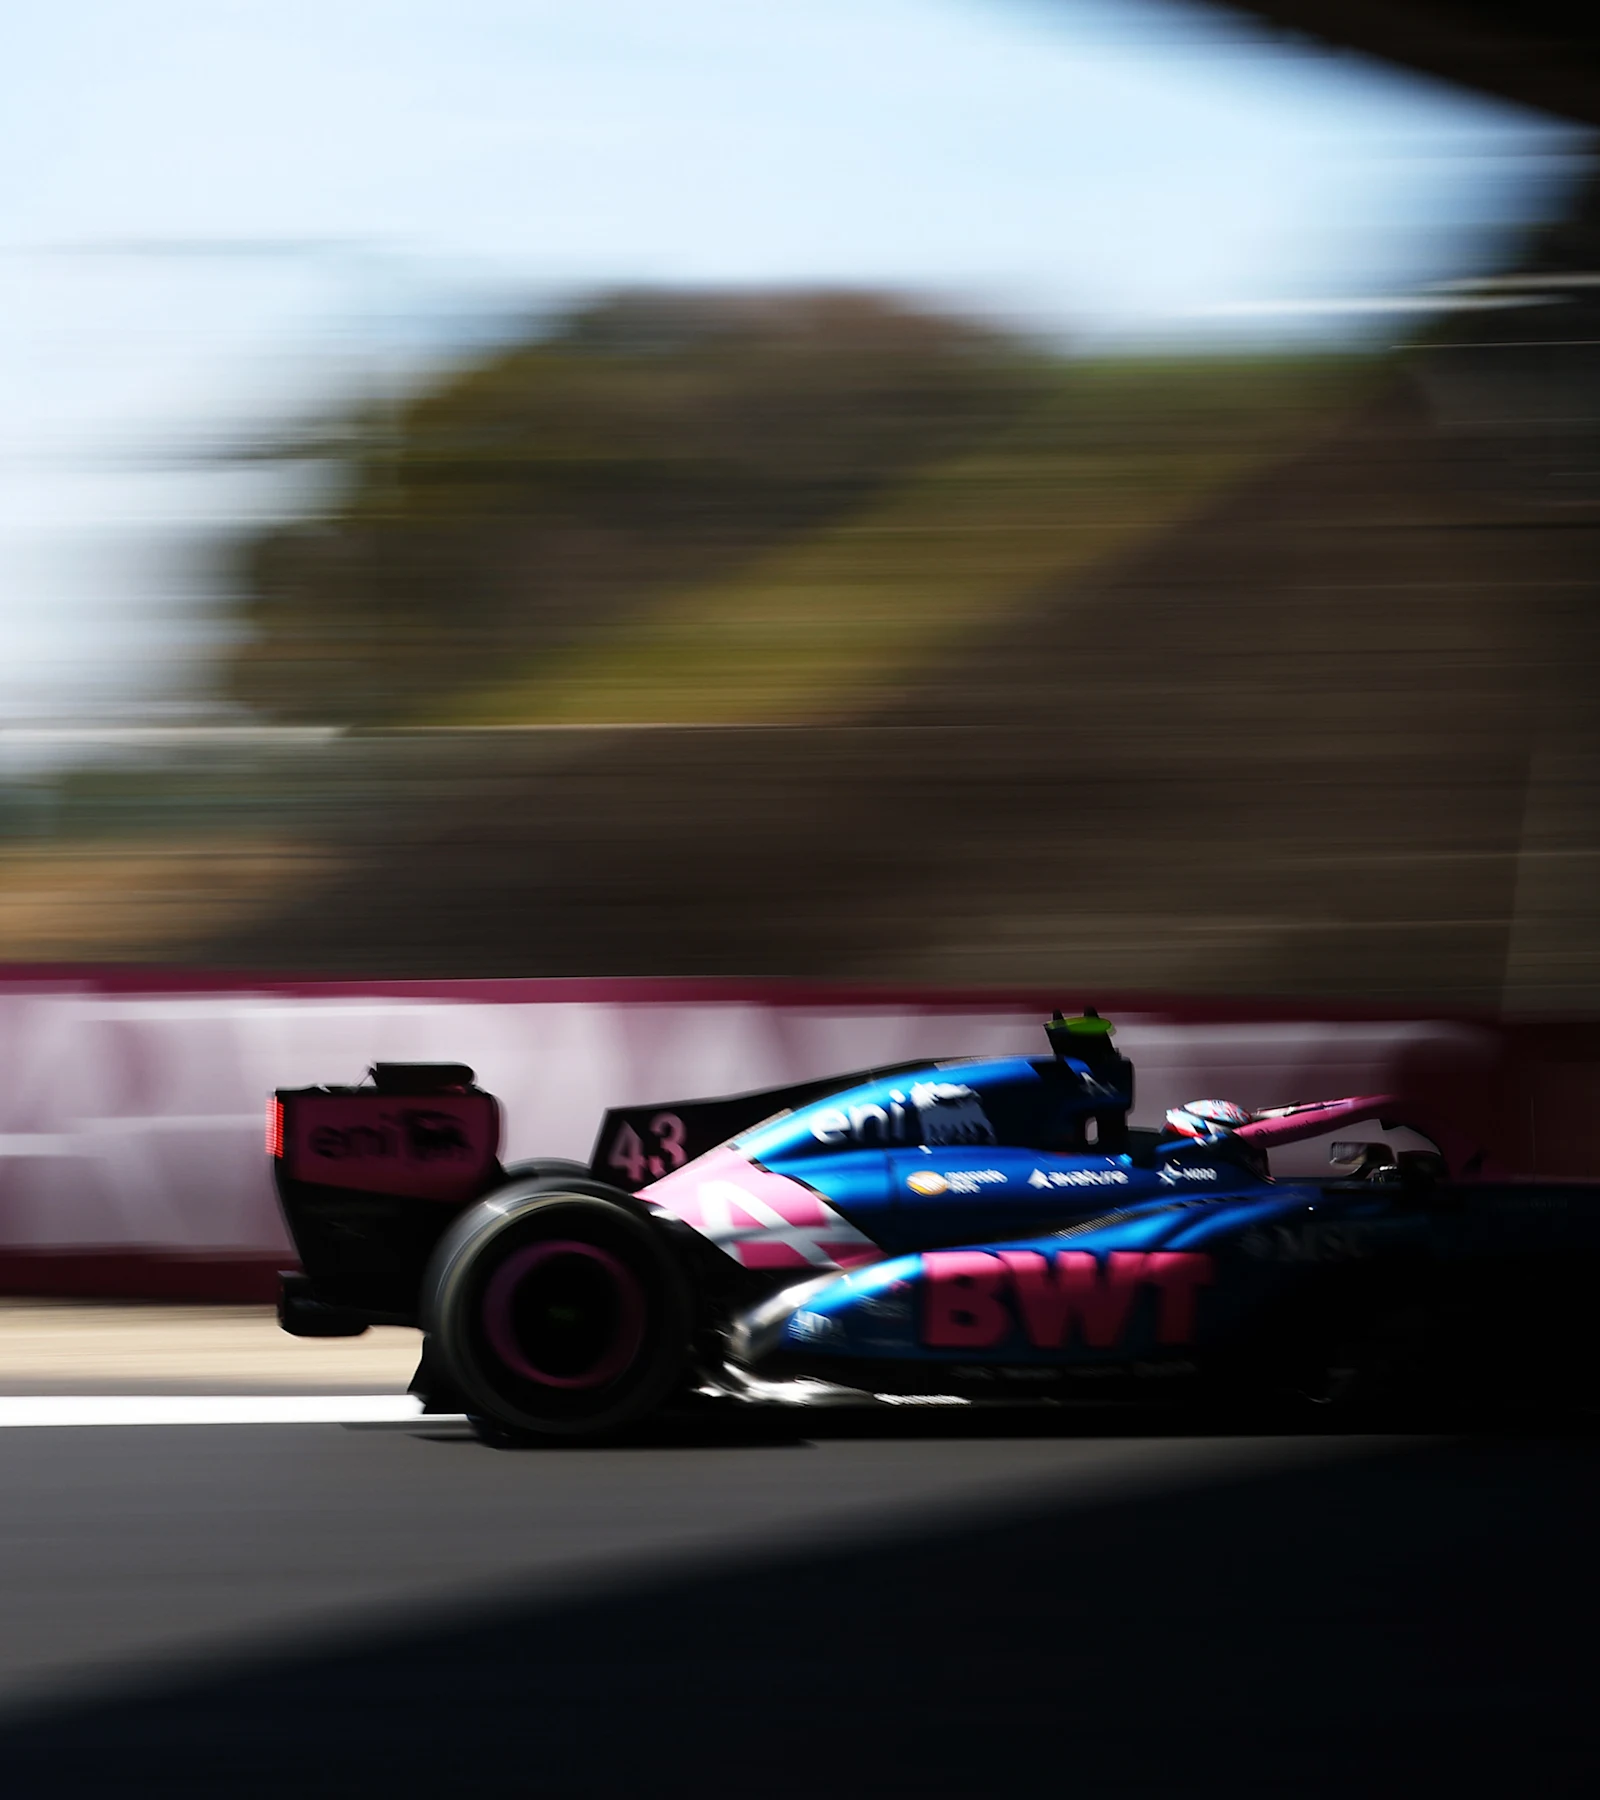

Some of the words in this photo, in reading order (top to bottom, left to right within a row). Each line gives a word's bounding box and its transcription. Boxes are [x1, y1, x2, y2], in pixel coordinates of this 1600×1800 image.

[309, 1112, 398, 1159] eni
[607, 1111, 688, 1183] 43
[810, 1089, 907, 1146] eni
[920, 1250, 1219, 1350] BWT
